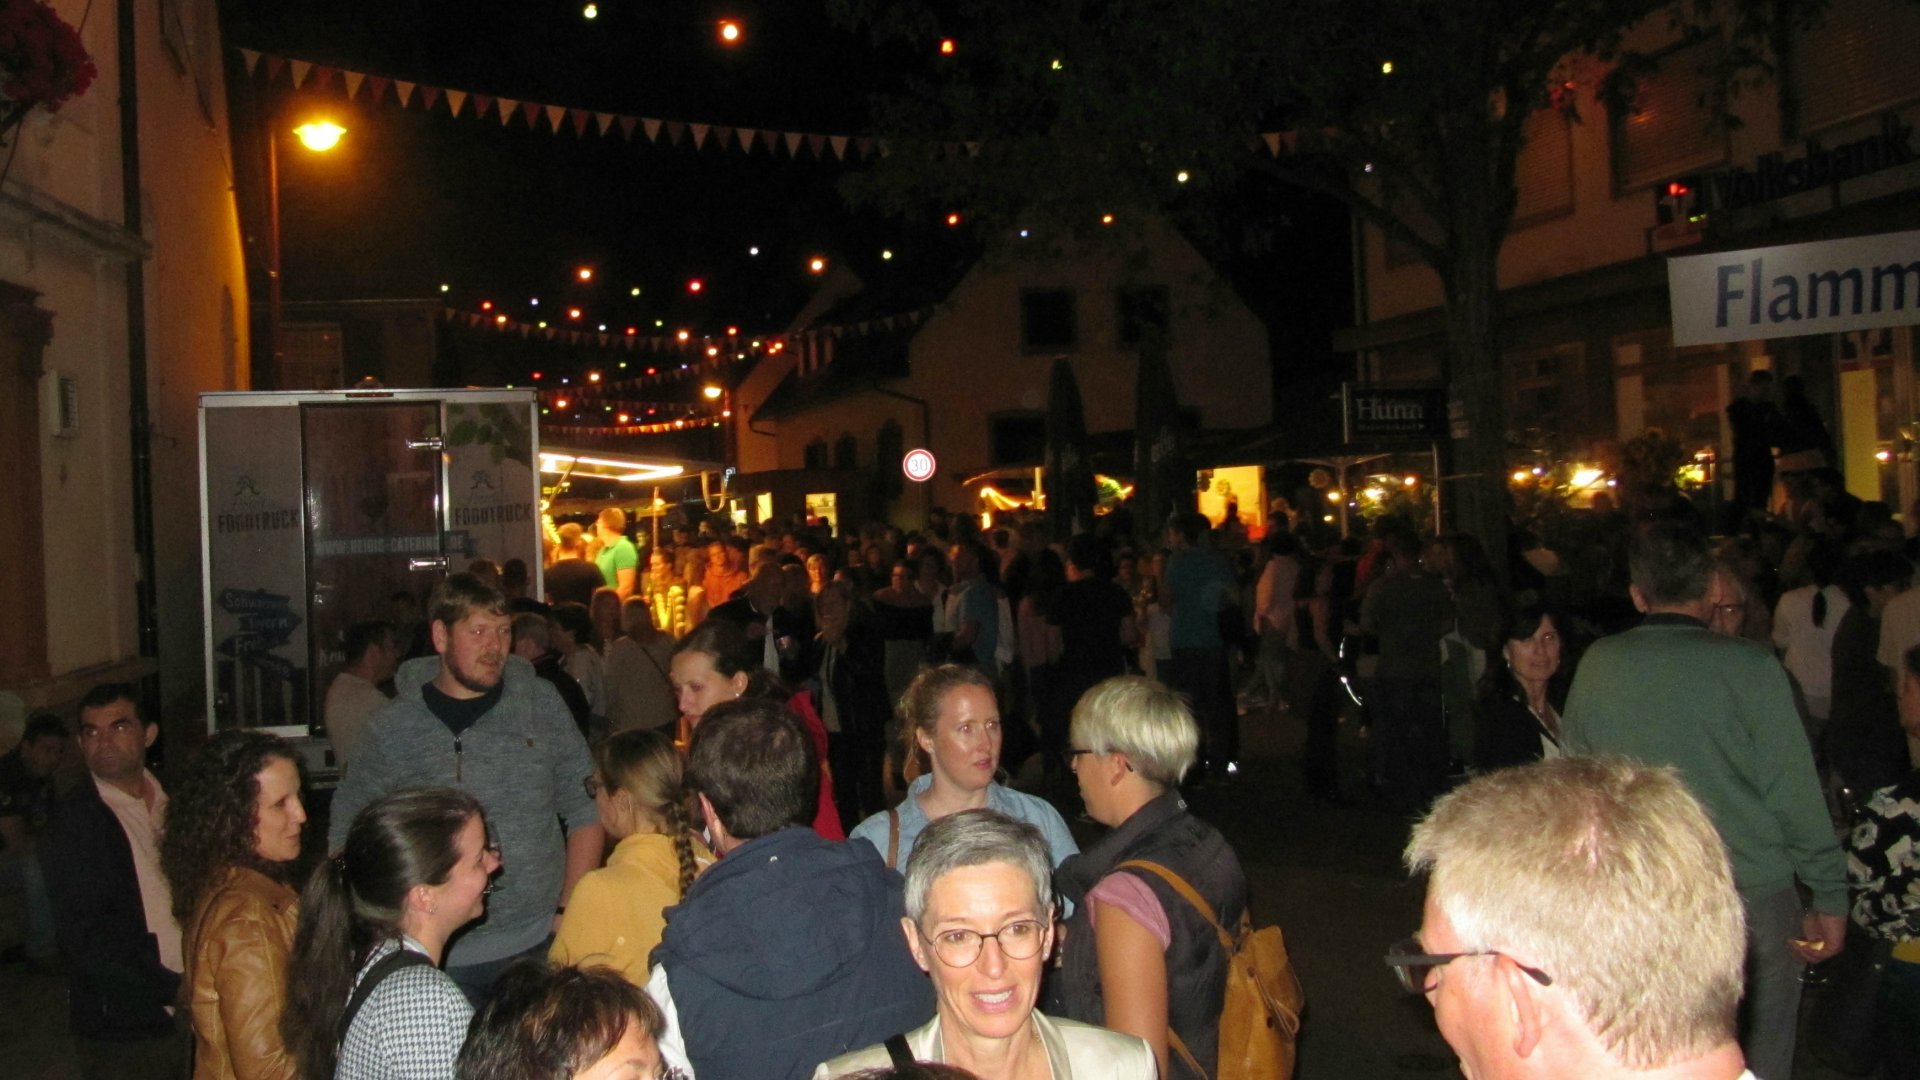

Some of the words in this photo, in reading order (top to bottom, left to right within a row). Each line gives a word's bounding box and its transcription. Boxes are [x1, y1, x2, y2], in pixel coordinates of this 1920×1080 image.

[1715, 112, 1914, 209] Volksbank
[911, 458, 928, 472] 30
[218, 510, 299, 533] FOODTRUCK
[455, 503, 531, 525] FOODTRUCK
